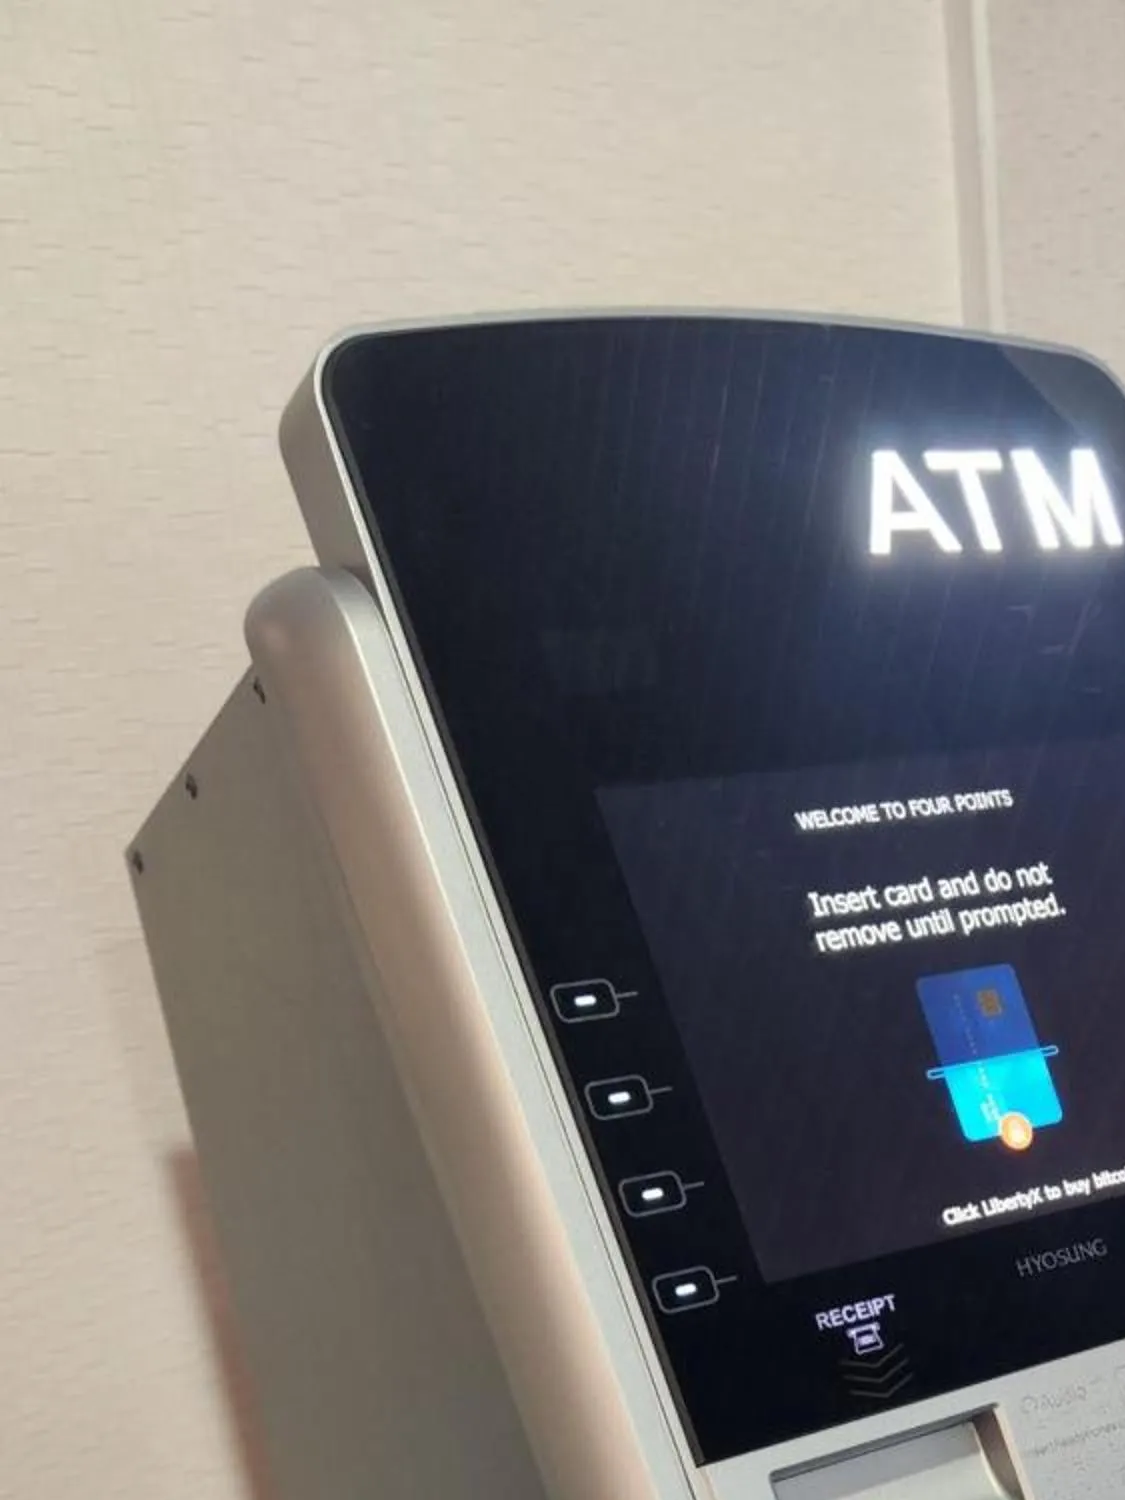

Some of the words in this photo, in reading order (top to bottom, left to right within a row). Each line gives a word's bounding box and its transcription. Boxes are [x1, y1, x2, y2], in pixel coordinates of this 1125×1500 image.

[868, 447, 1125, 555] ATM
[794, 803, 880, 830] WELCOME
[880, 801, 906, 820] TO
[907, 796, 954, 817] FOUR
[953, 788, 1014, 812] POINTS
[807, 885, 882, 918] Insert
[884, 876, 934, 907] card
[938, 870, 980, 900] and
[983, 867, 1012, 893] do
[1016, 860, 1054, 889] not
[815, 919, 902, 952] remove
[905, 907, 956, 939] until
[957, 891, 1067, 936] prompted.
[942, 1203, 982, 1226] Click
[981, 1187, 1044, 1217] LibertyX
[1043, 1184, 1062, 1201] to
[1062, 1177, 1091, 1196] buy
[1015, 1238, 1108, 1277] HYOSUNG
[815, 1294, 896, 1330] RECEIPT
